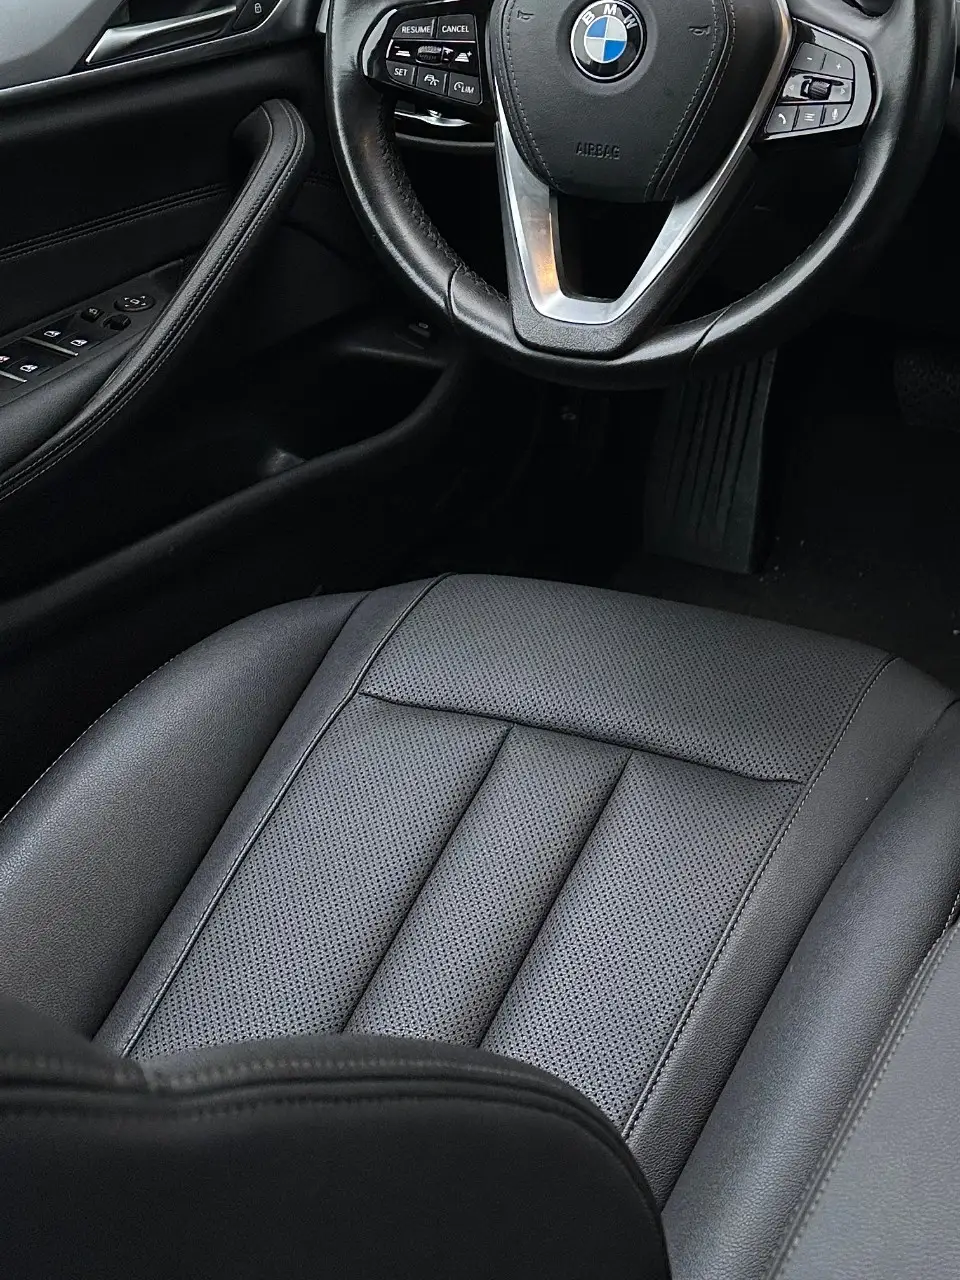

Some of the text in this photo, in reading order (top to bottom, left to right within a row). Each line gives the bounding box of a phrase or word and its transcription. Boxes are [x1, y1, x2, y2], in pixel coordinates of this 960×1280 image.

[581, 3, 638, 30] BMW
[401, 26, 431, 34] RESUME
[441, 25, 470, 33] CANCEL
[394, 68, 408, 76] SET
[461, 85, 474, 94] LIM
[575, 141, 621, 160] AIRBAG
